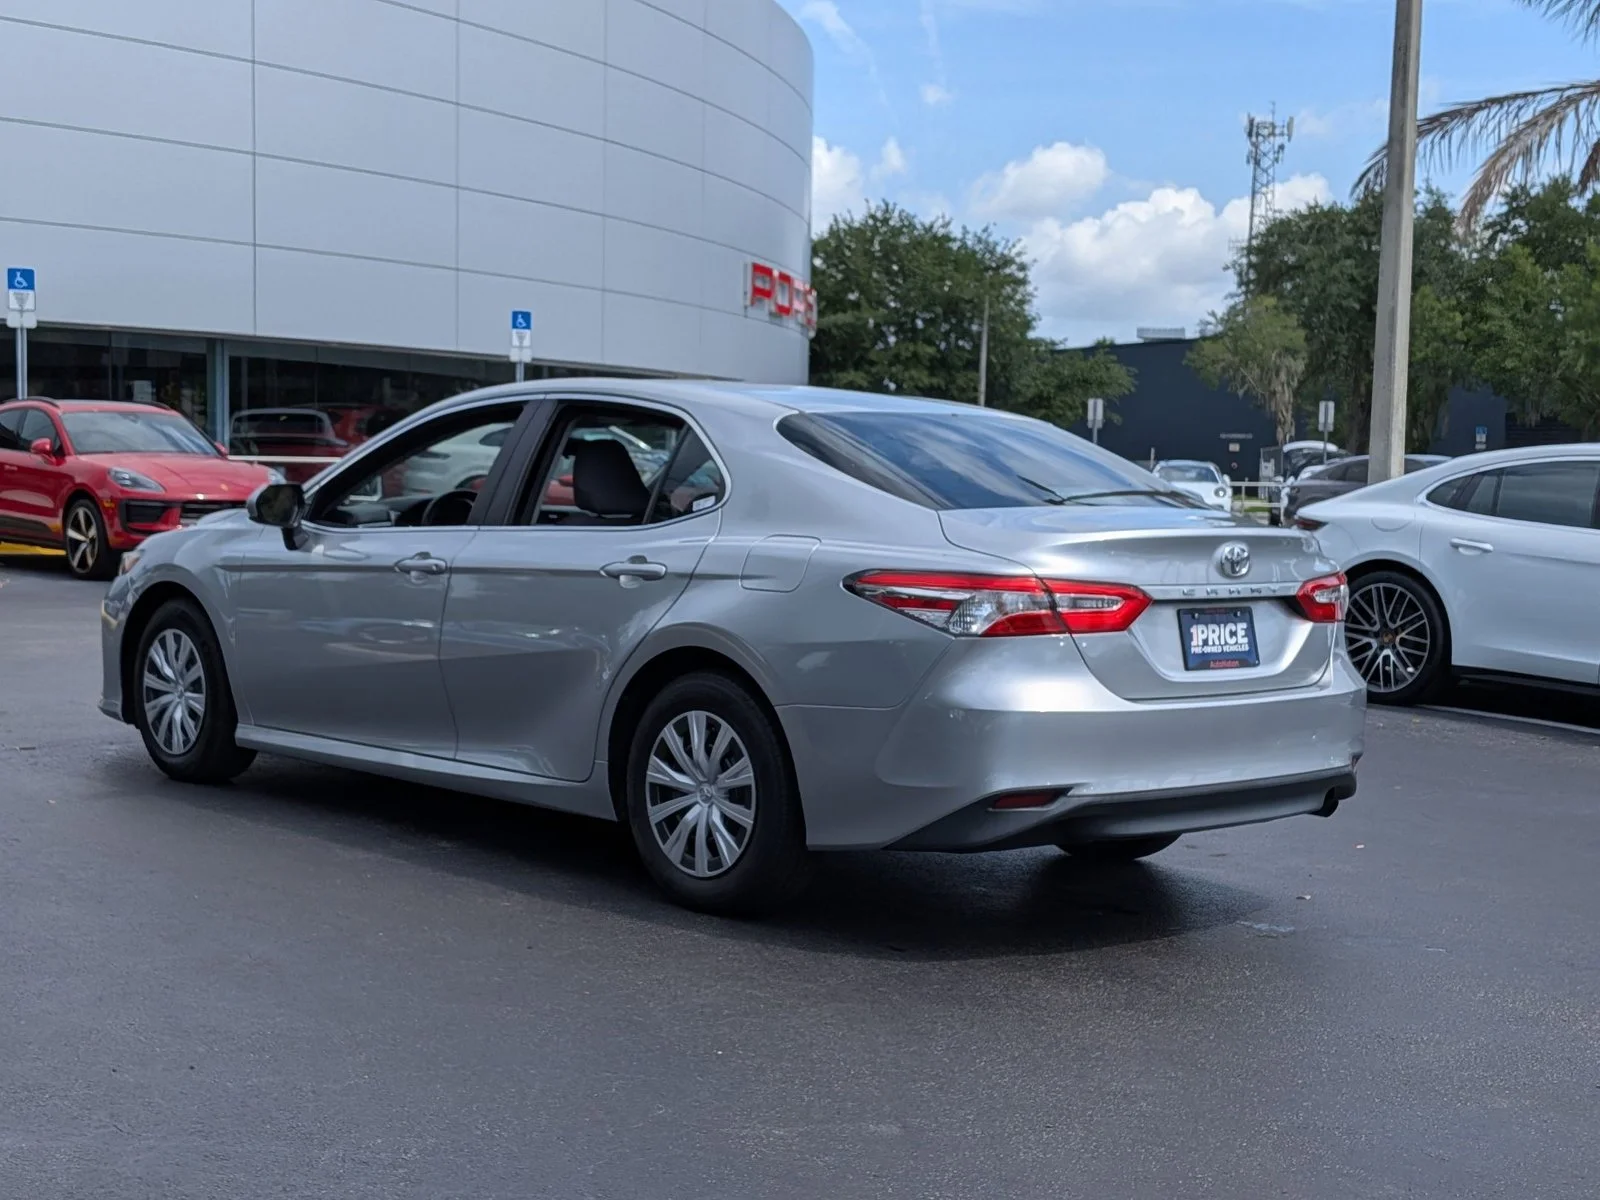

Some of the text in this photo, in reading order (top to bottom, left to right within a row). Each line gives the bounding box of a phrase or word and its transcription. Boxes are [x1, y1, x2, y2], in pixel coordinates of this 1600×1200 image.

[1190, 623, 1248, 646] 1PRICE
[1191, 644, 1249, 654] PRE-OWNED VEHICLES
